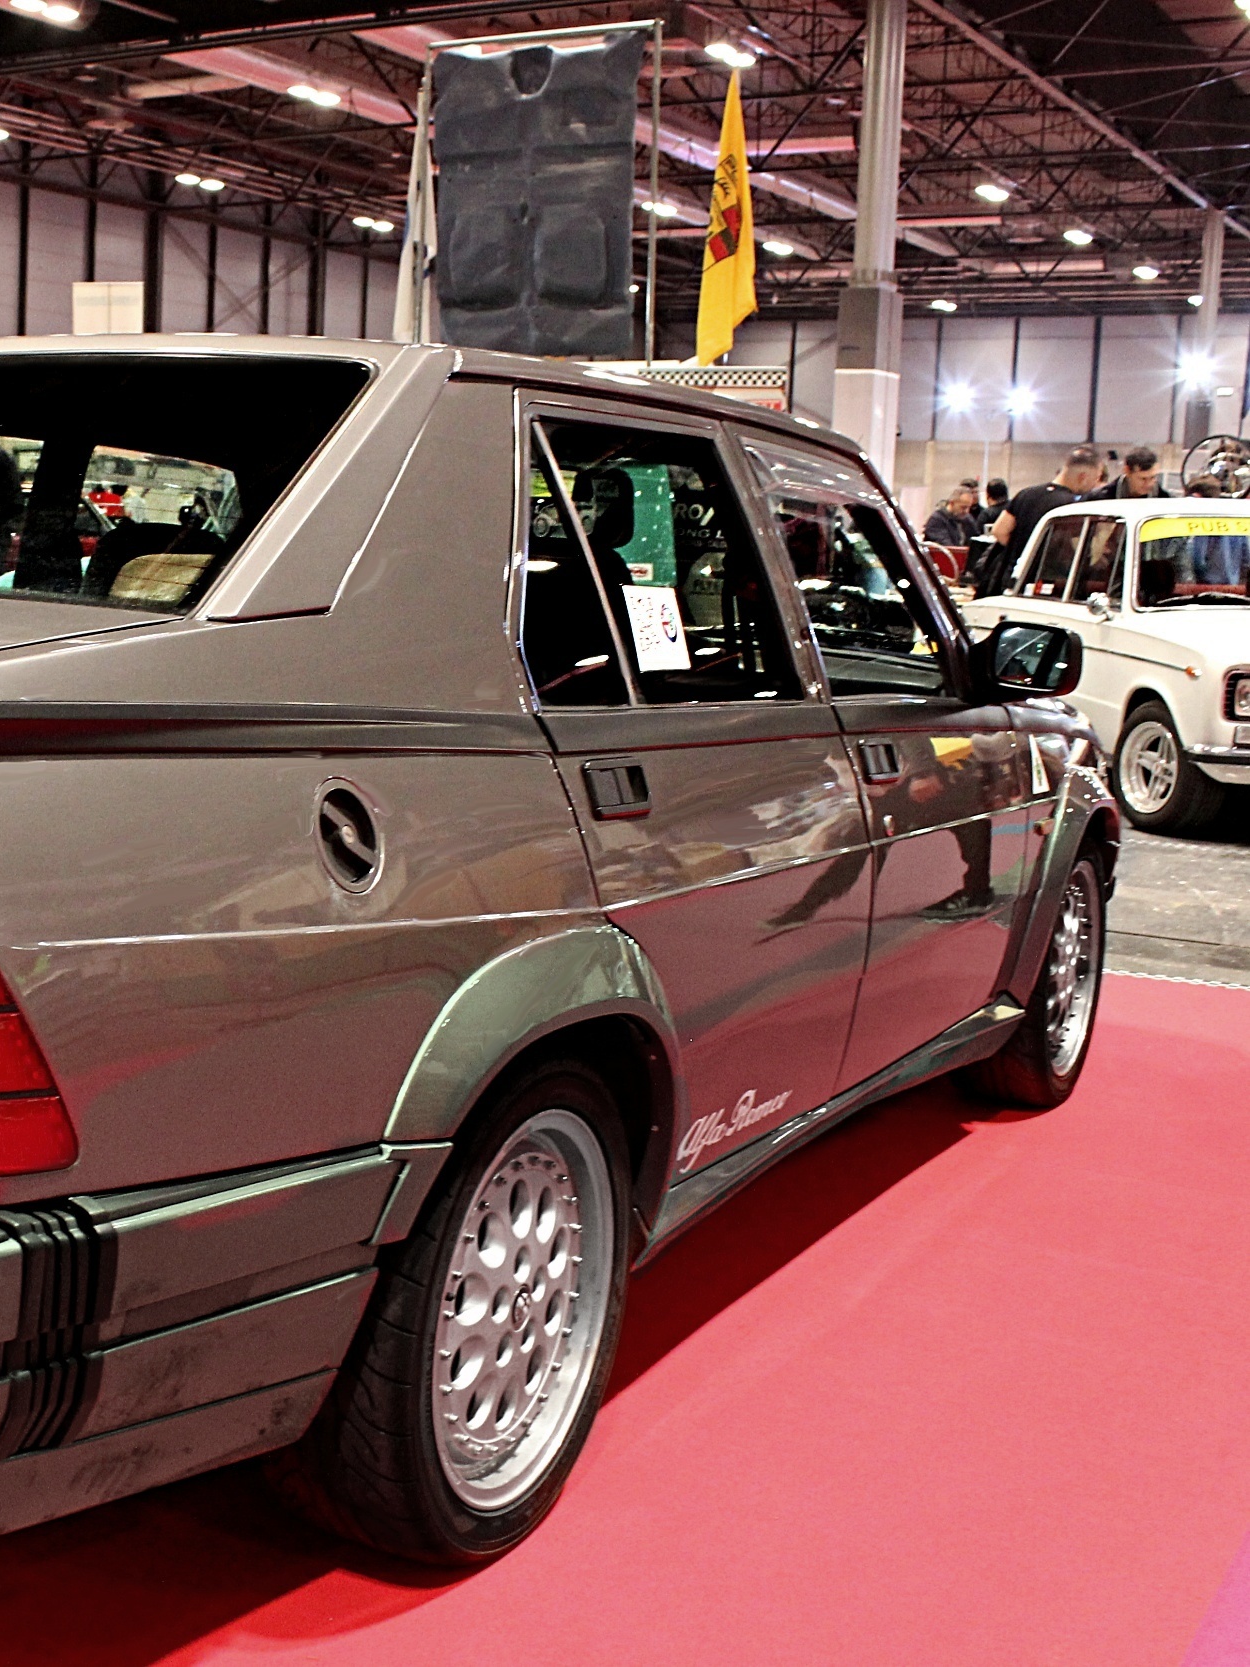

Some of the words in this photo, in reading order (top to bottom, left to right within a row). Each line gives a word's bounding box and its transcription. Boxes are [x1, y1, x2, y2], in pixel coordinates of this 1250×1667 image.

[1187, 521, 1229, 534] PUB
[676, 1108, 728, 1174] Alfa
[725, 1089, 793, 1136] Romeo
